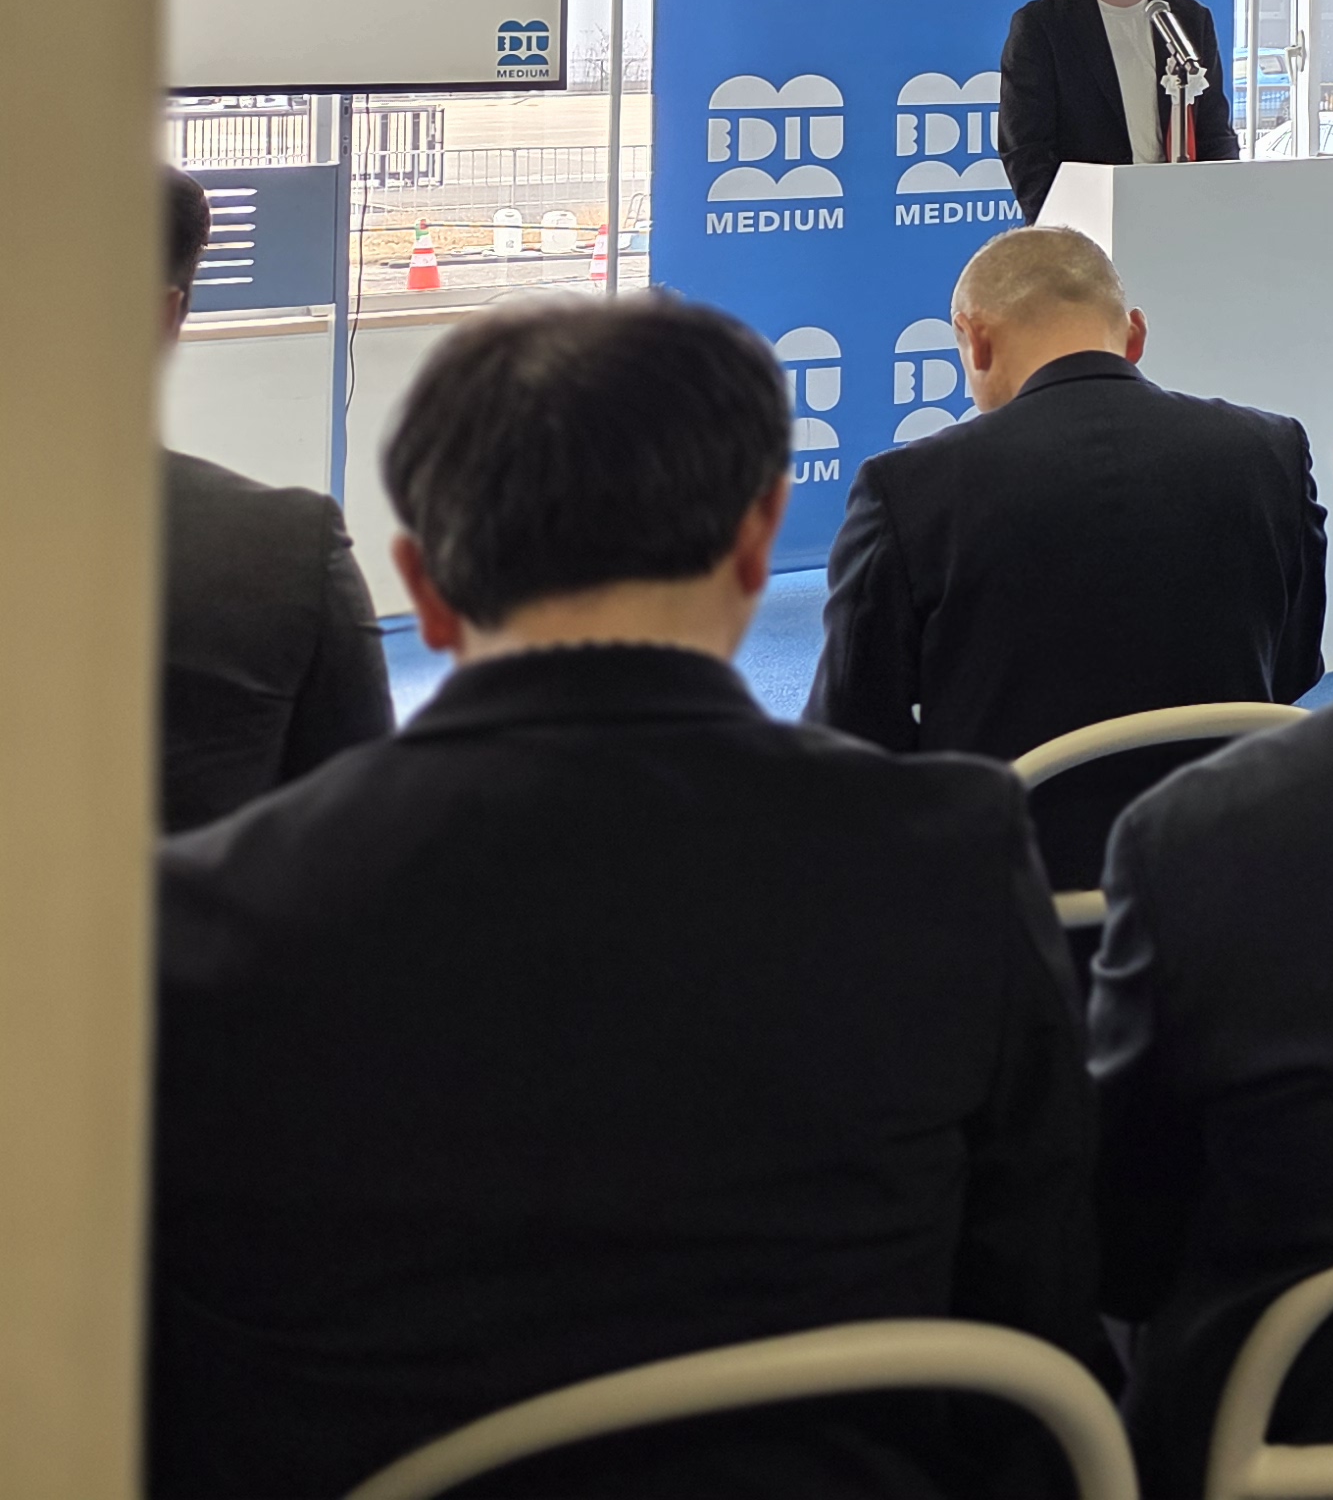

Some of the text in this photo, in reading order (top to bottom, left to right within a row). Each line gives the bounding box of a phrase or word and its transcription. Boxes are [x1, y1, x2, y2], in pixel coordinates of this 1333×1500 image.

[497, 69, 550, 78] MEDIUM
[706, 207, 844, 234] MEDIUM
[895, 200, 1023, 226] MEDIUM
